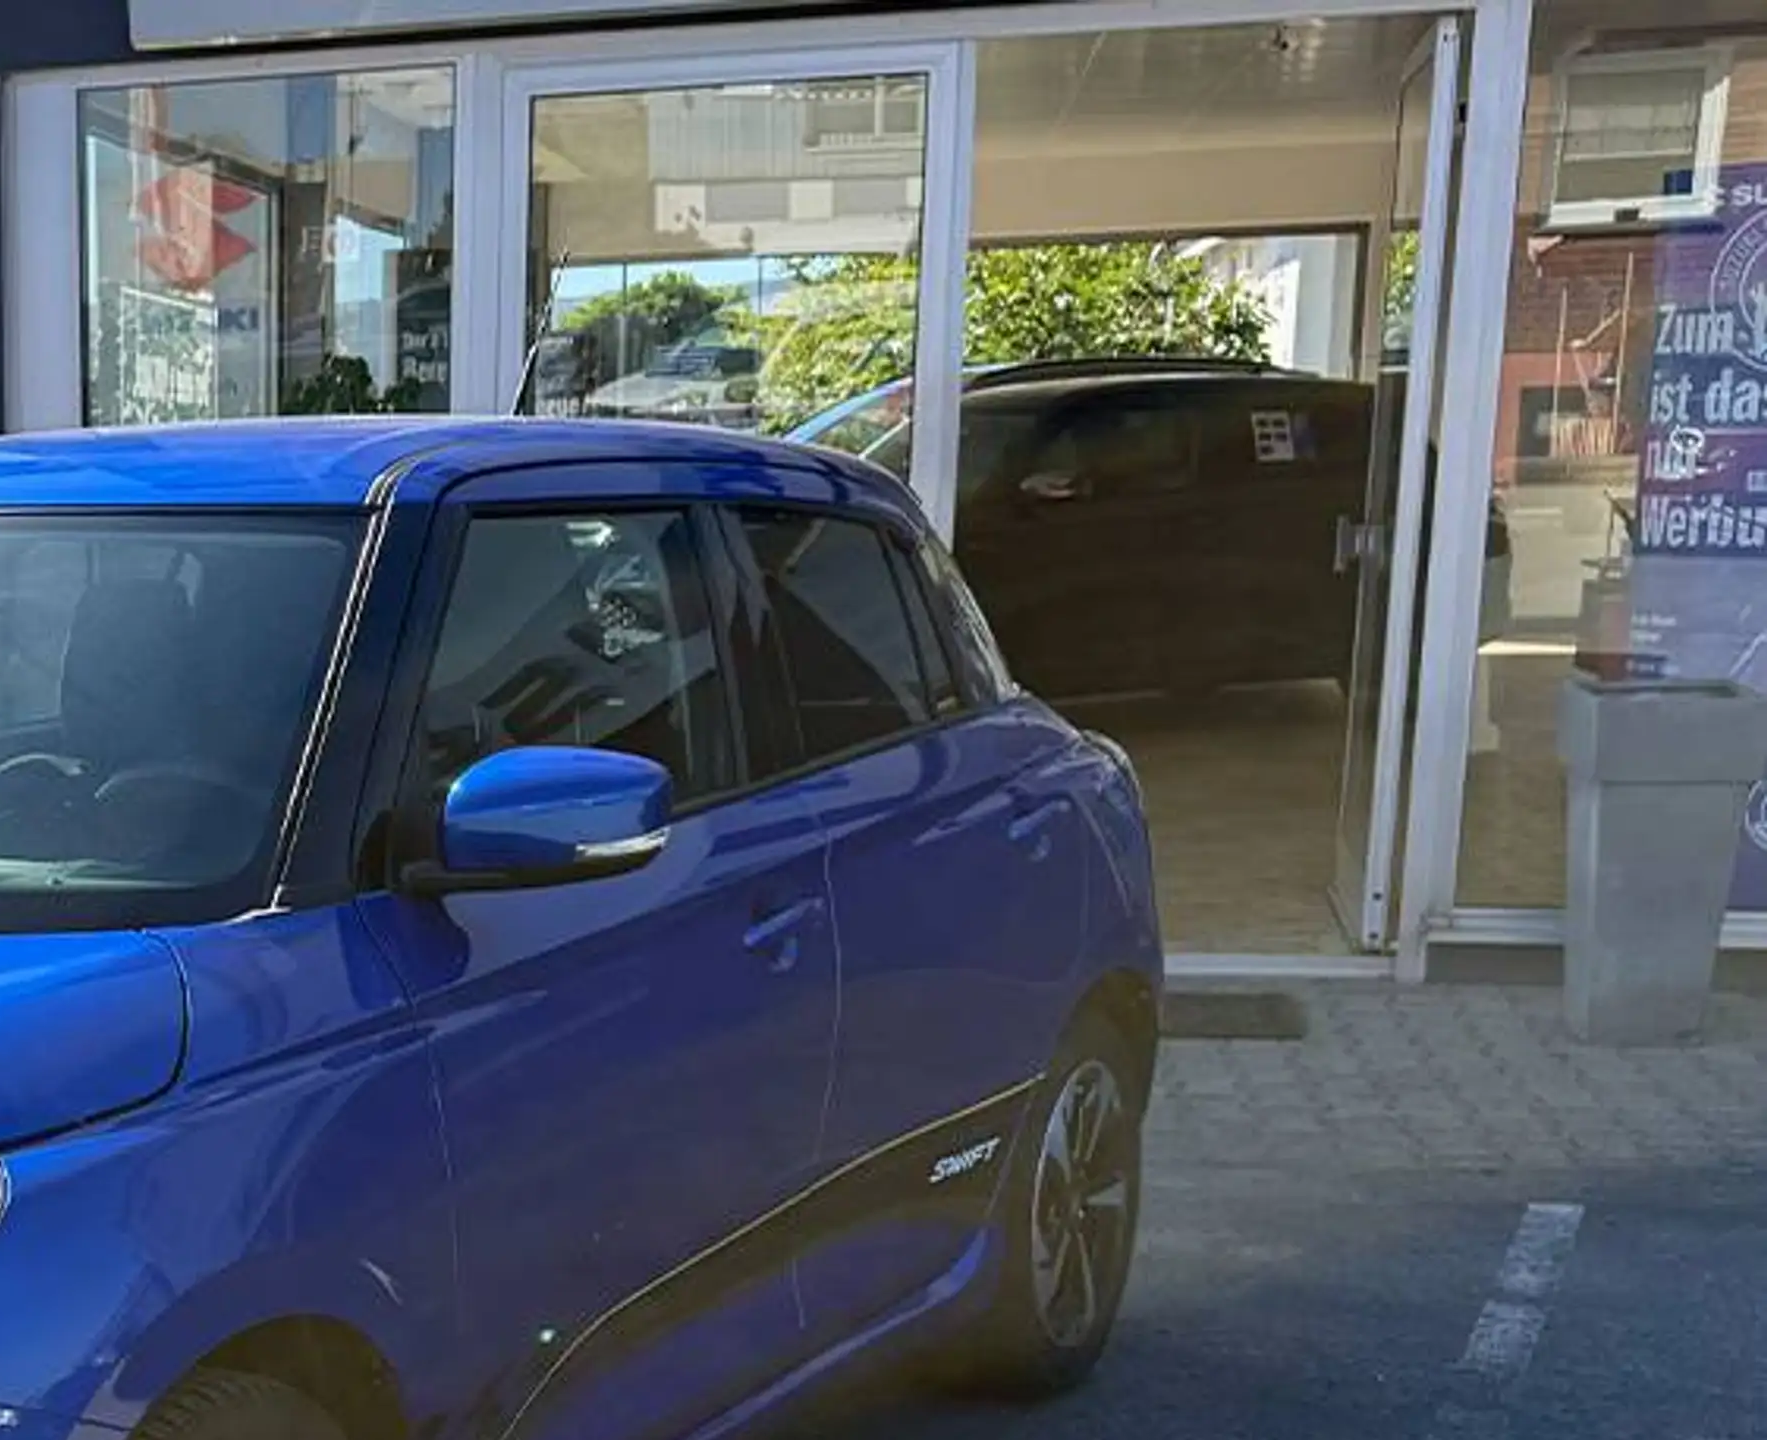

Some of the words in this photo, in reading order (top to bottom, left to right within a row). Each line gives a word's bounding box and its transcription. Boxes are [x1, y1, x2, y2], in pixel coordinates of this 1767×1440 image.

[1654, 304, 1734, 353] Zum
[1650, 370, 1693, 423] ist
[928, 1137, 1002, 1184] SWIFT
